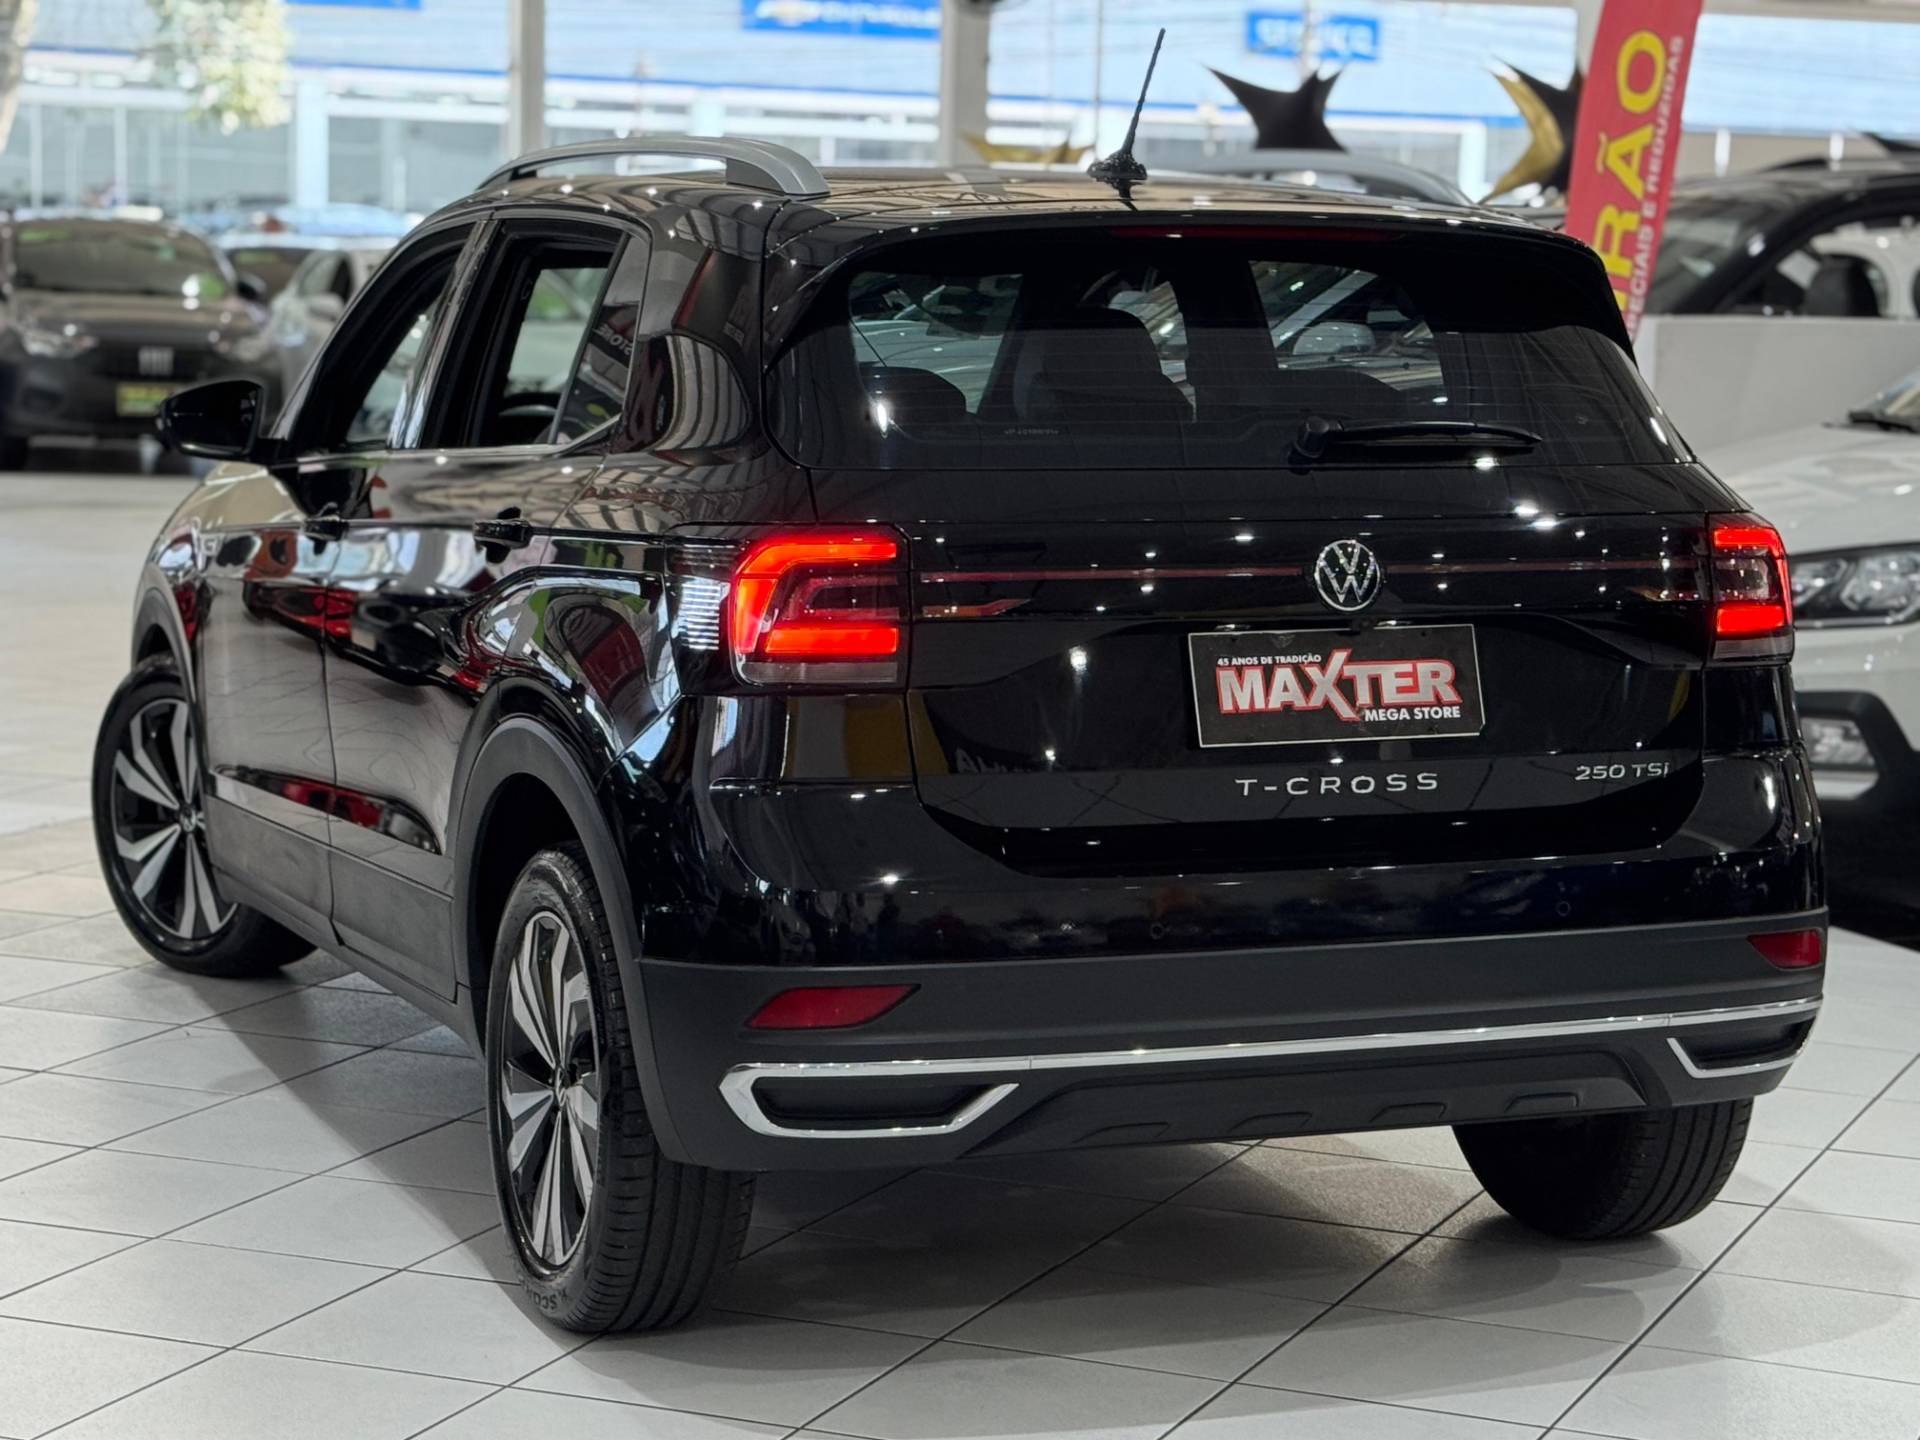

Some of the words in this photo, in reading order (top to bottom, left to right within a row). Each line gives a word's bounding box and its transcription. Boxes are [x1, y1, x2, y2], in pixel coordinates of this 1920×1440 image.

[1627, 224, 1655, 345] PECIAIS
[1231, 656, 1259, 666] ANOS
[1260, 655, 1273, 665] DE
[1274, 652, 1322, 665] TRADIÇÃO
[1217, 648, 1462, 722] MAXTER
[1364, 707, 1411, 722] MEGA
[1413, 705, 1461, 720] STORE
[1575, 764, 1626, 781] 250
[1234, 772, 1438, 796] T-CROSS
